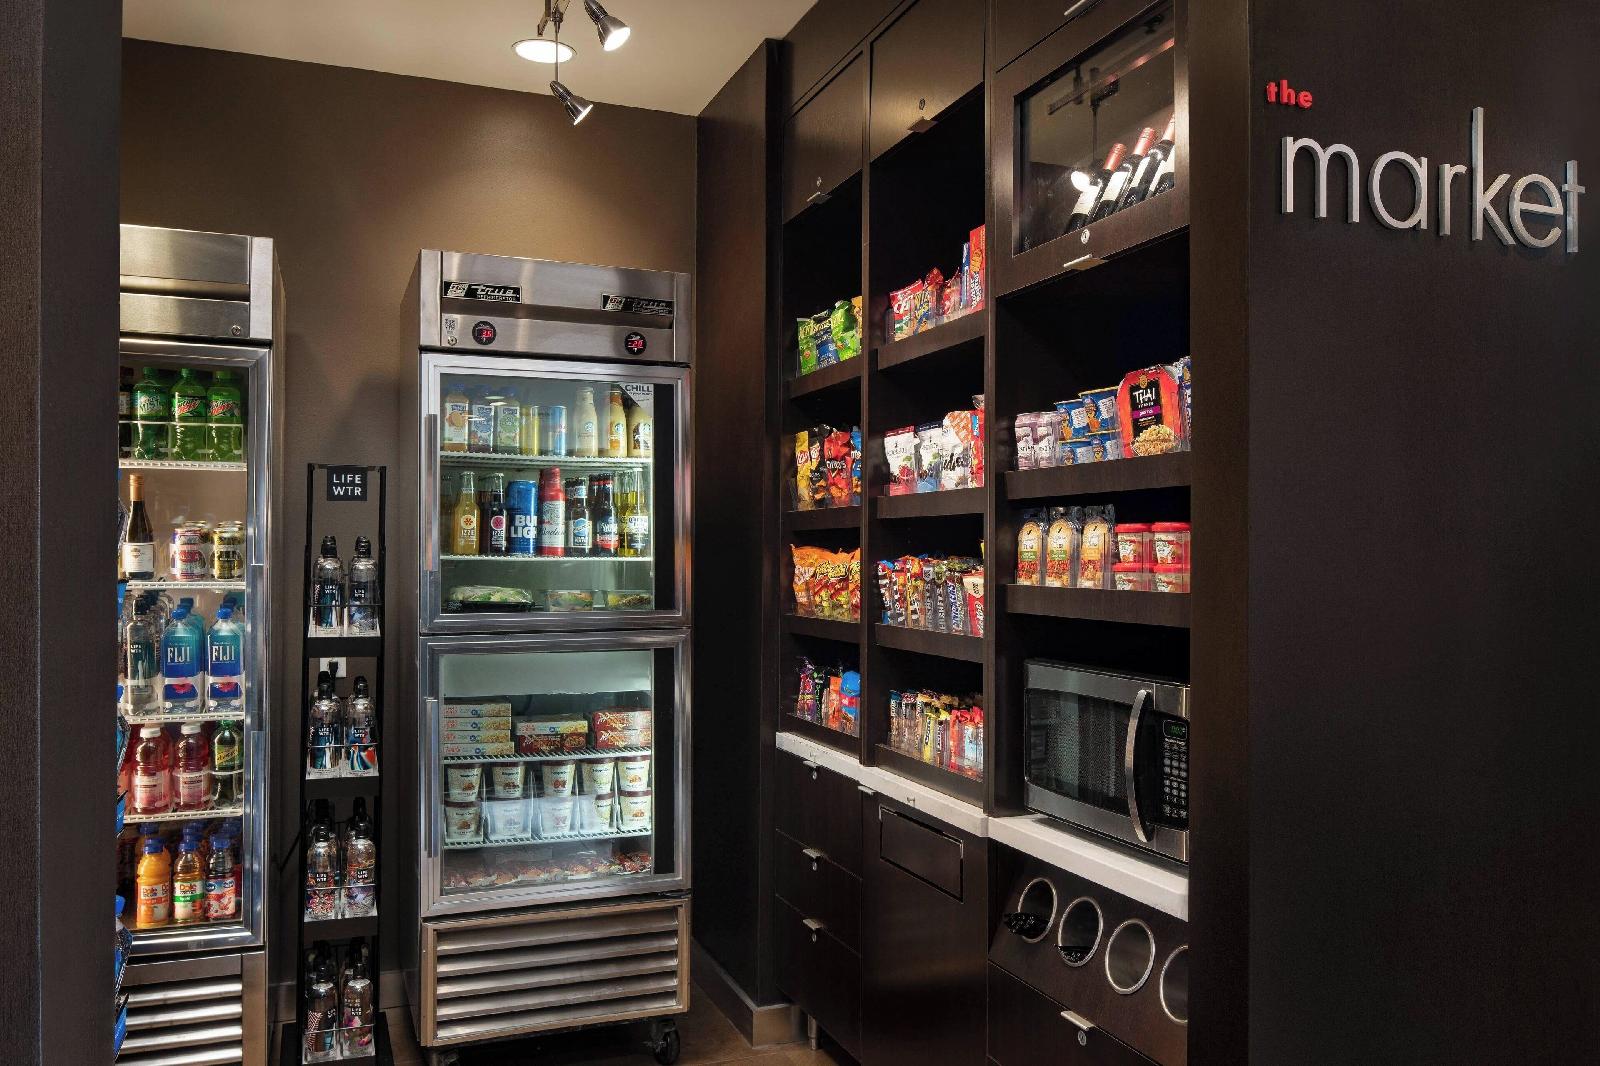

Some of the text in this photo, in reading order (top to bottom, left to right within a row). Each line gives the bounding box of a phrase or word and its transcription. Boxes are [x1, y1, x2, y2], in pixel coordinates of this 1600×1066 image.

[1266, 79, 1313, 109] the
[1281, 106, 1586, 254] market
[624, 384, 653, 393] CHILL
[1133, 388, 1156, 404] THAI
[333, 473, 362, 484] LIFE
[332, 486, 362, 496] WTR
[167, 646, 191, 663] FIJI
[211, 645, 235, 662] FIJI
